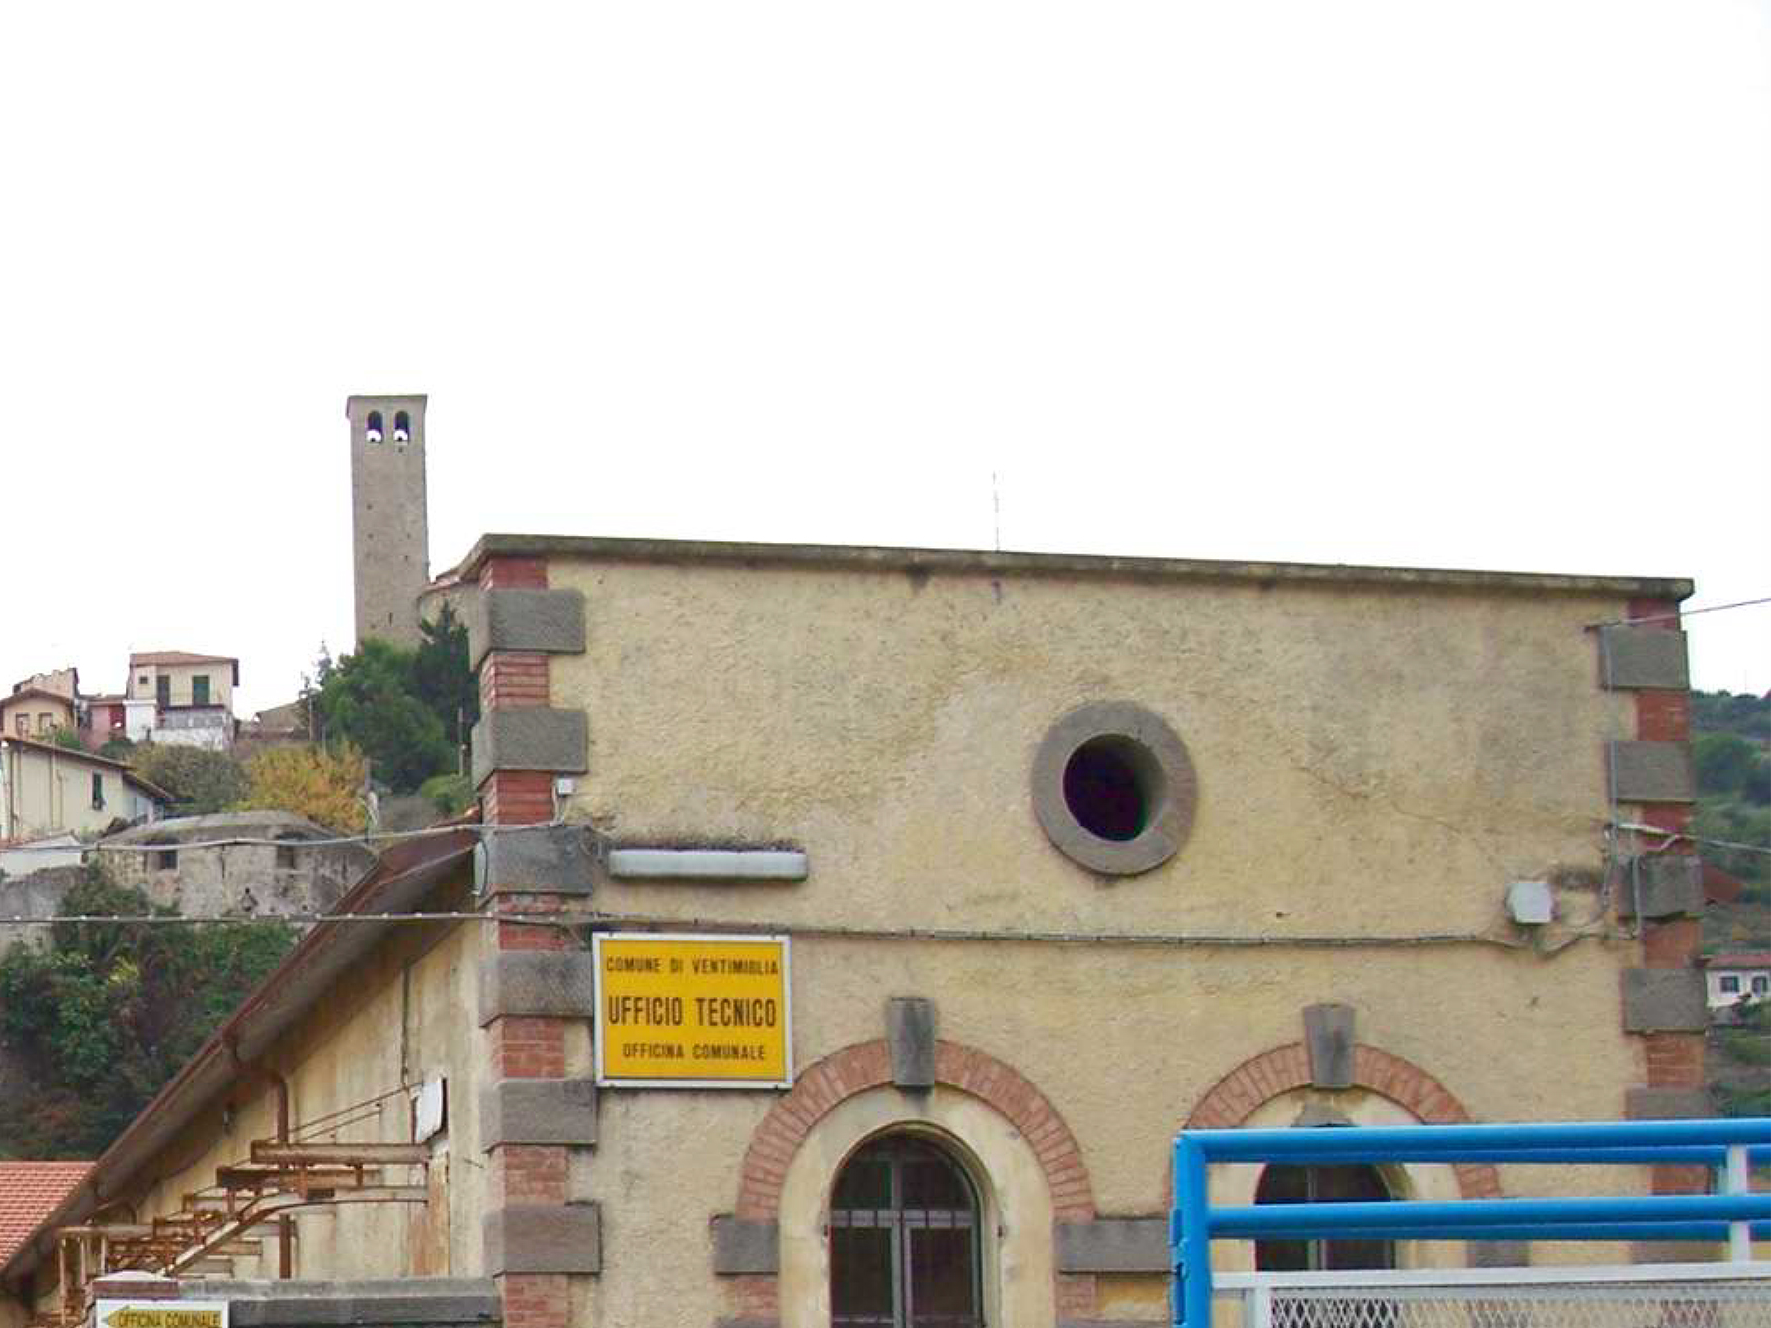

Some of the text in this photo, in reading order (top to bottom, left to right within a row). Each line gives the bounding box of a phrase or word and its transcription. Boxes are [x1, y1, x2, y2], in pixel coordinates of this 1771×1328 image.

[606, 956, 779, 975] COMUNE DI VENTIMIGLIA
[607, 996, 777, 1027] UFFICIO TECNICO
[622, 1042, 766, 1060] OFFICINA COMUNALE
[118, 1311, 221, 1328] OFFICINA COMUNALE
